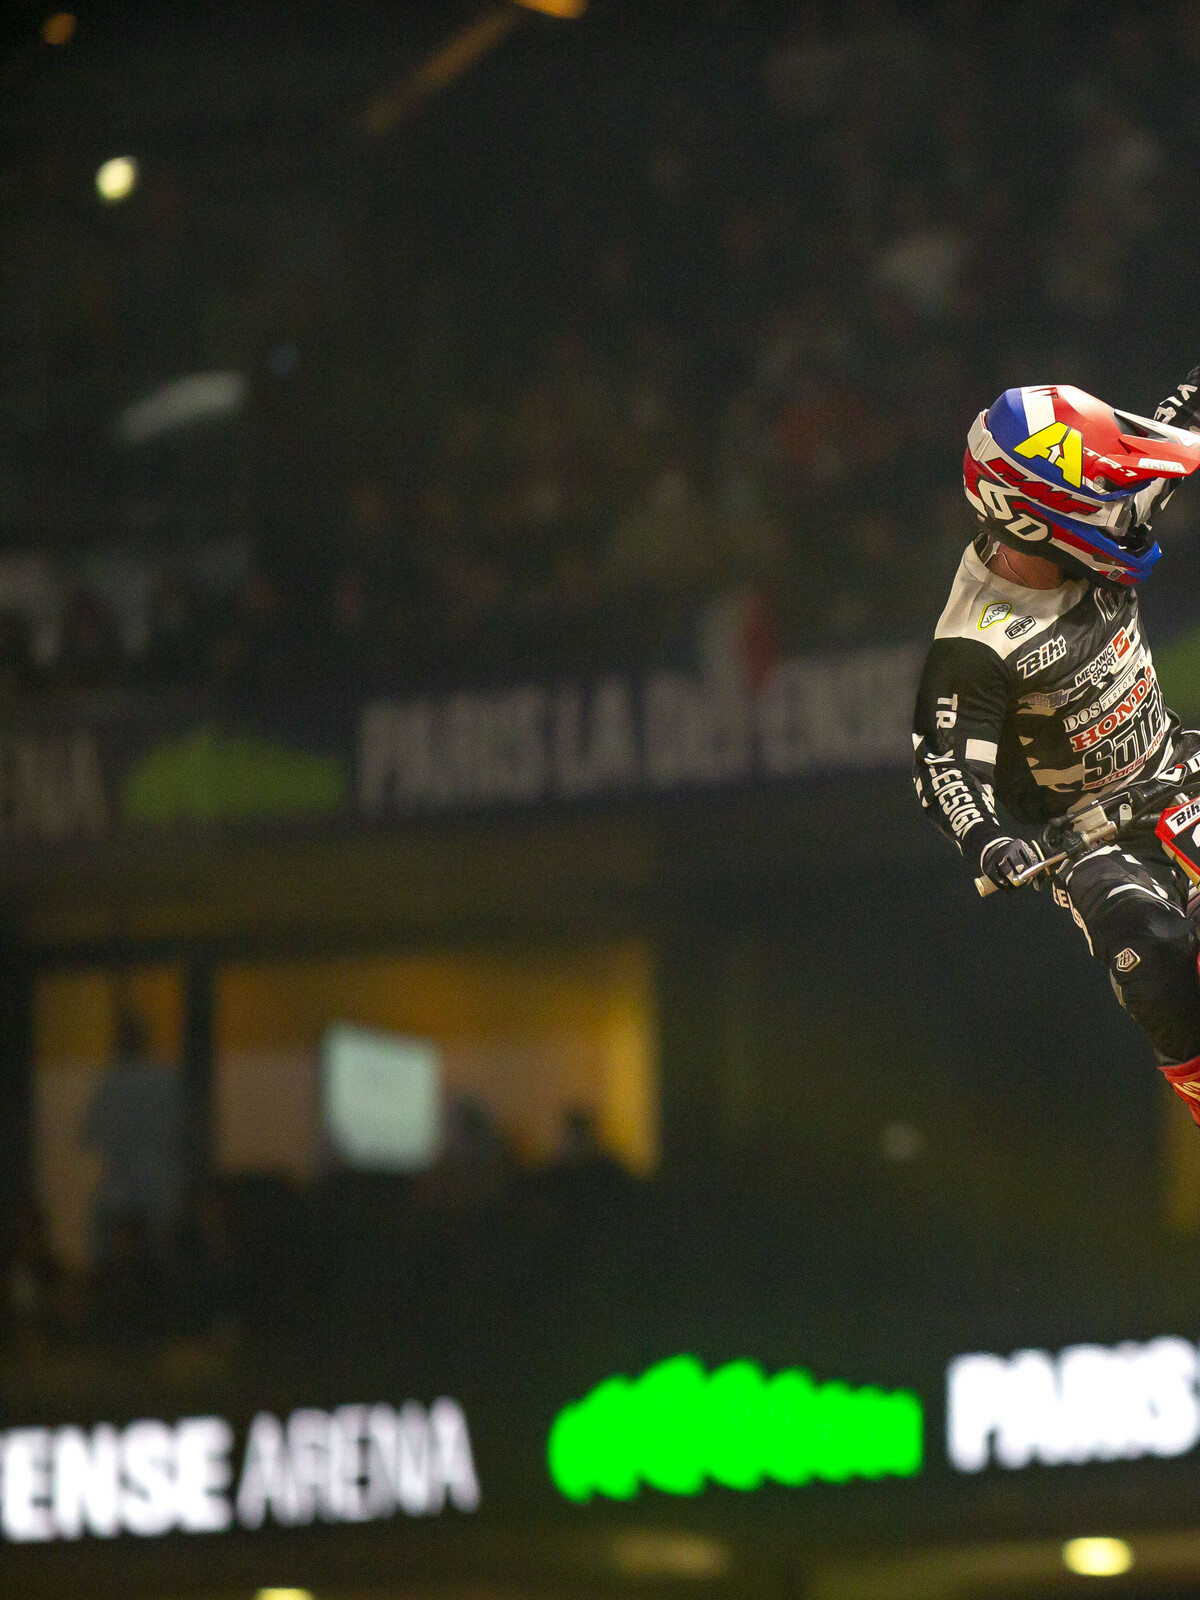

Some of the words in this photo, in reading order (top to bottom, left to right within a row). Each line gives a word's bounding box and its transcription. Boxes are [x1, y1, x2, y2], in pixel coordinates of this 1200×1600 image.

[983, 604, 1010, 625] YACCO
[1064, 701, 1101, 732] DOS
[1103, 655, 1144, 709] PERFORMAN
[1075, 645, 1113, 686] MECANIC
[1092, 654, 1117, 684] SPORT
[947, 1335, 1199, 1473] PARIS
[237, 1396, 482, 1530] ARENA
